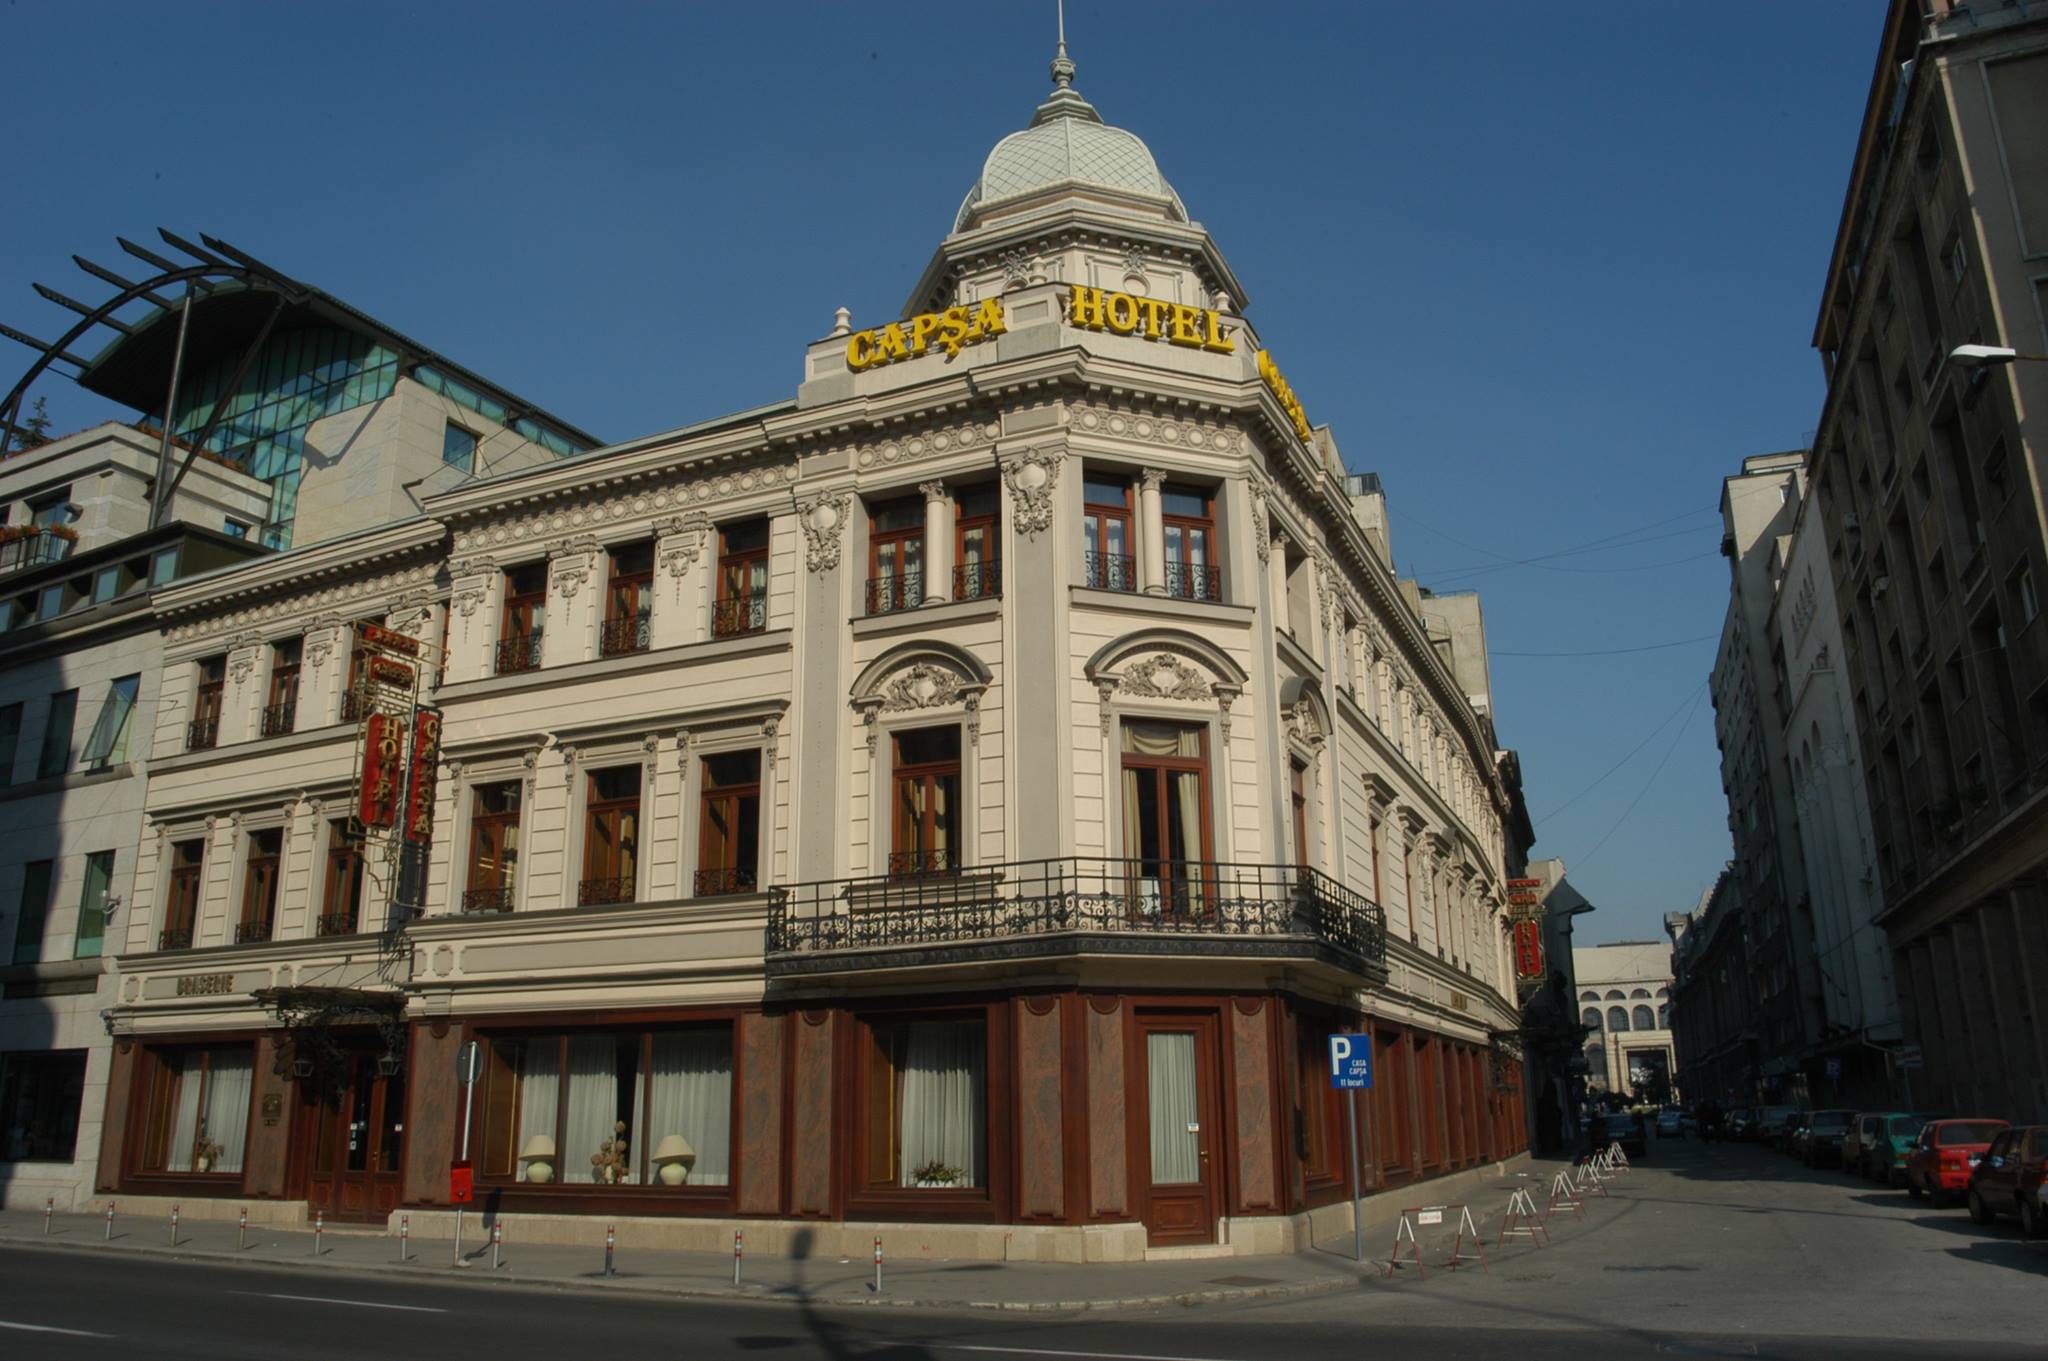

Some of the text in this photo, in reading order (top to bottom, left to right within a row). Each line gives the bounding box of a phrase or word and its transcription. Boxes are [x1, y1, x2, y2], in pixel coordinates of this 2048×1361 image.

[847, 297, 1008, 369] CAPŞA
[1070, 283, 1235, 353] HOTEL
[1331, 1037, 1351, 1075] P
